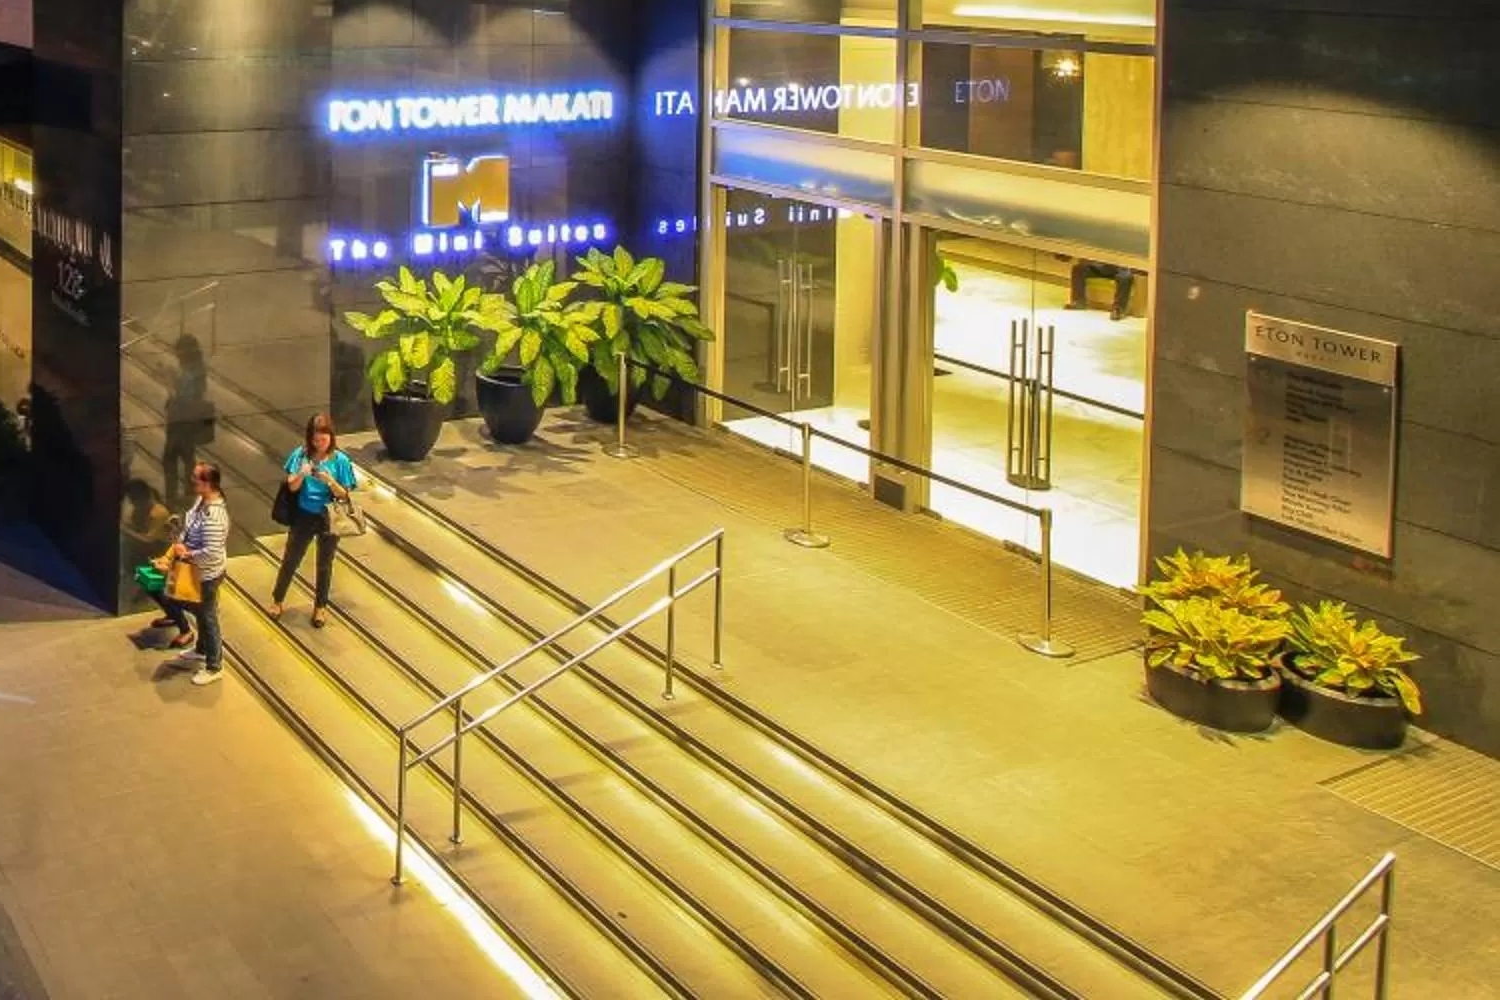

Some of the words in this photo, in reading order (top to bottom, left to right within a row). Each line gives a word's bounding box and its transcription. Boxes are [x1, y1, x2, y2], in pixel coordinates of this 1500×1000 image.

[395, 94, 499, 130] TOWER
[503, 90, 613, 124] MAKATI
[955, 79, 1009, 105] ETON
[1255, 325, 1305, 347] ETON
[1313, 337, 1381, 363] TOWER
